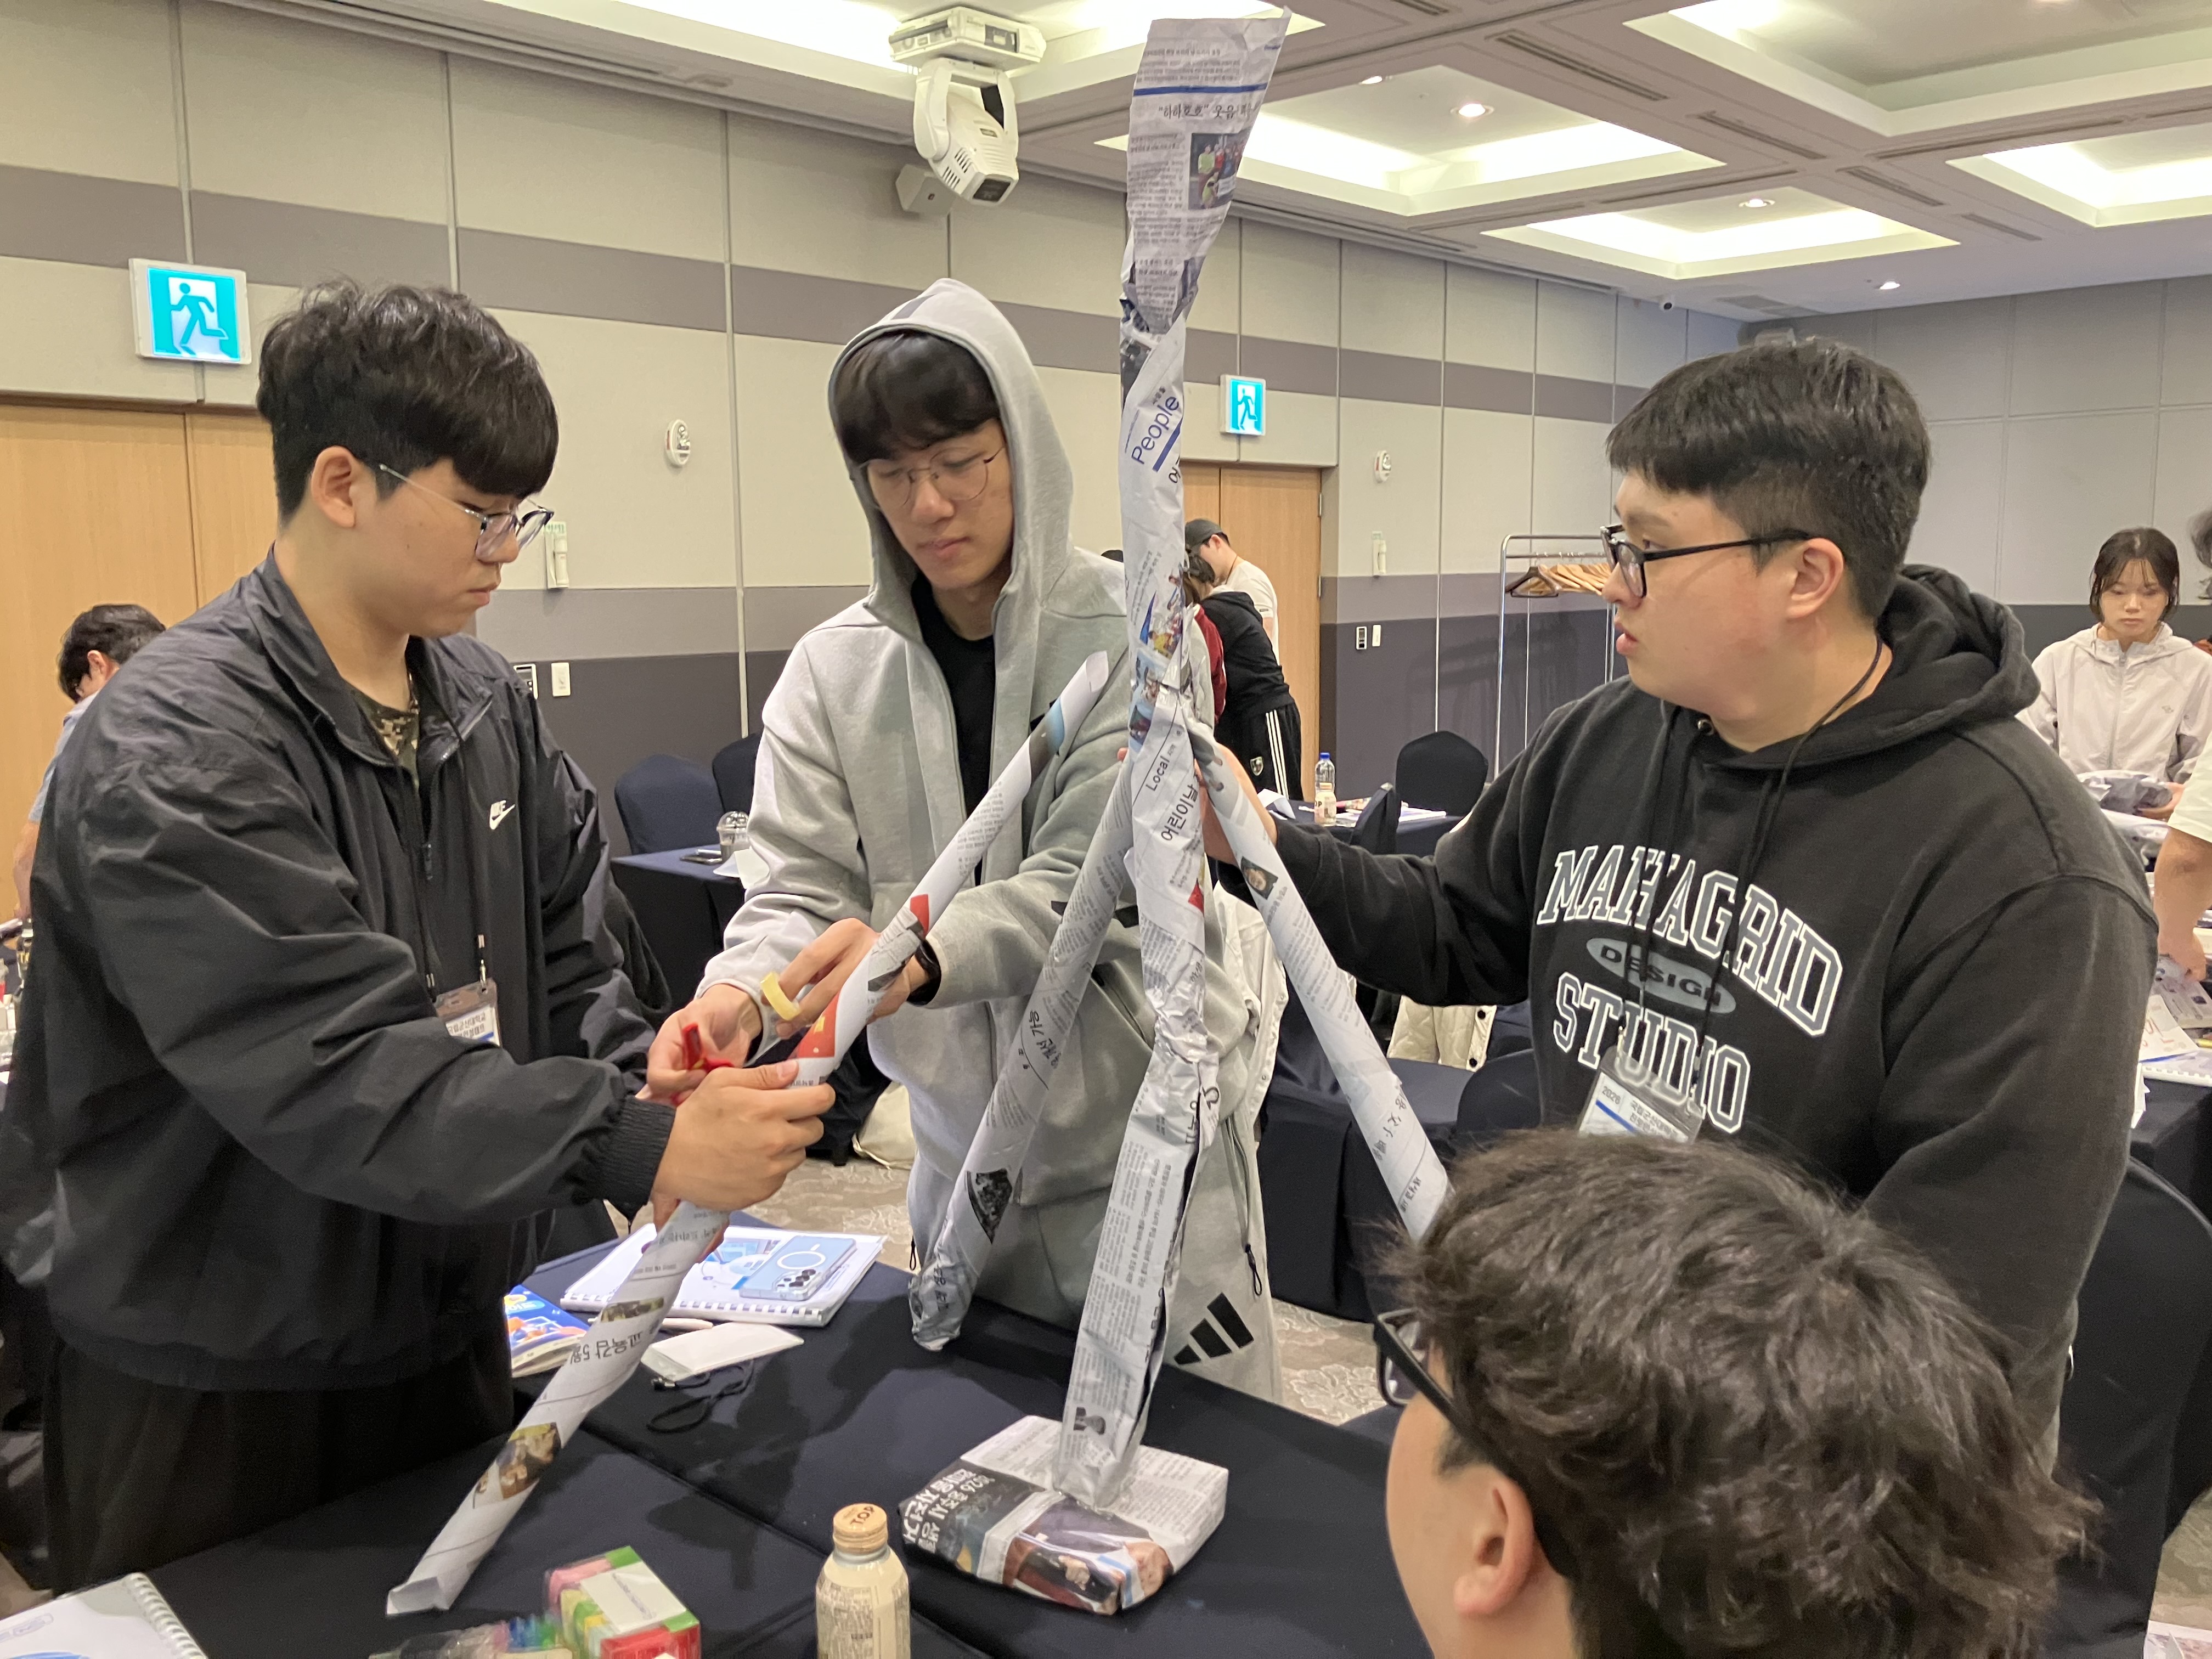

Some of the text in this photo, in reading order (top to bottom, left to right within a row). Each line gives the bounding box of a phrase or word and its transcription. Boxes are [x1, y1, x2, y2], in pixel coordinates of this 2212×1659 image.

[1131, 396, 1180, 464] People
[1146, 755, 1170, 791] Local
[1161, 783, 1199, 842] 어린이날
[1536, 845, 1842, 1036] MAHAGRID
[1600, 945, 1722, 1006] DESIGN
[1553, 971, 1751, 1134] STUDIO
